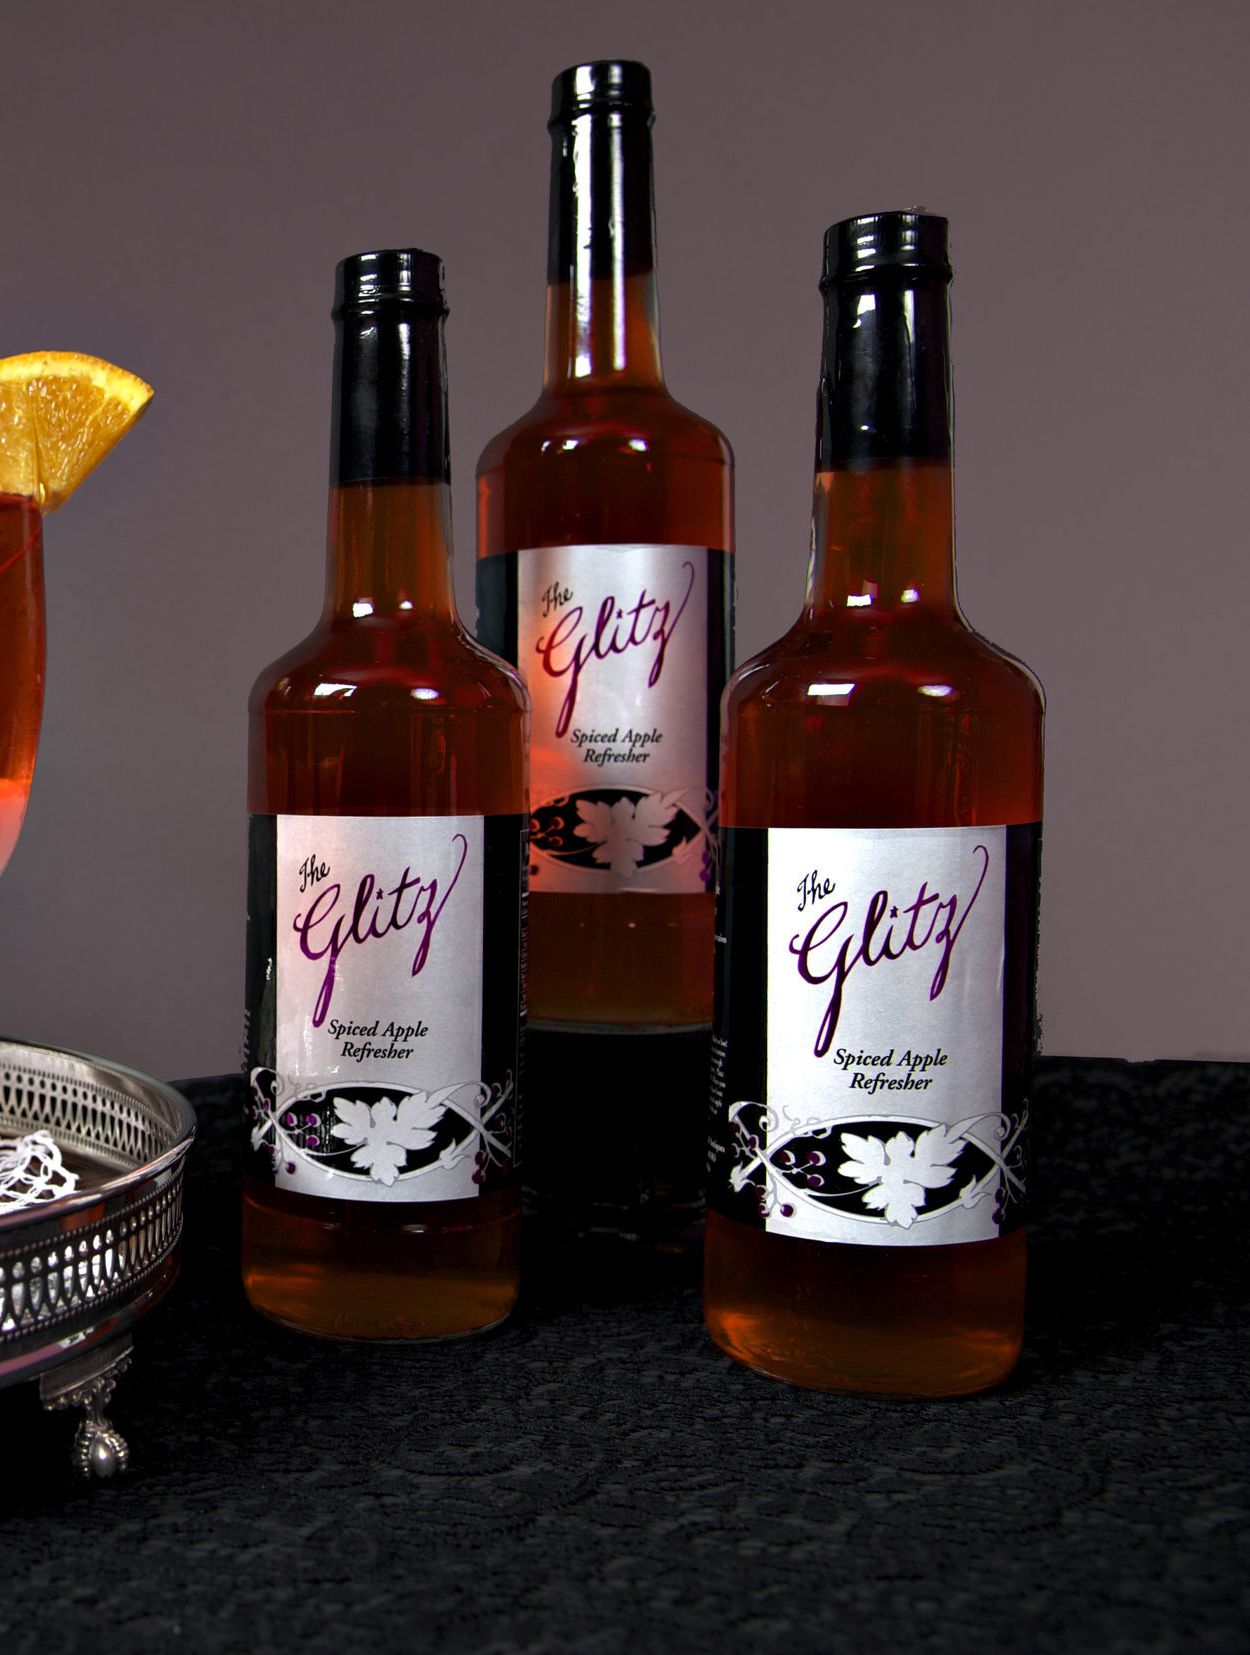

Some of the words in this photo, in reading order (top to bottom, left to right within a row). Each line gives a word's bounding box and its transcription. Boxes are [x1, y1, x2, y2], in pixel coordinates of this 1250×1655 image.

[542, 582, 573, 617] The
[535, 561, 695, 738] Glitz
[570, 728, 619, 746] Spiced
[621, 729, 663, 746] Apple
[584, 748, 650, 767] Refresher
[299, 854, 330, 893] The
[797, 869, 836, 912] The
[293, 833, 467, 1028] Glitz
[788, 845, 989, 1058] Glitz
[328, 1019, 379, 1039] Spiced
[381, 1021, 428, 1041] Apple
[340, 1041, 414, 1062] Refresher
[833, 1048, 895, 1070] Spiced
[897, 1048, 948, 1071] Apple
[849, 1072, 933, 1094] Refresher
